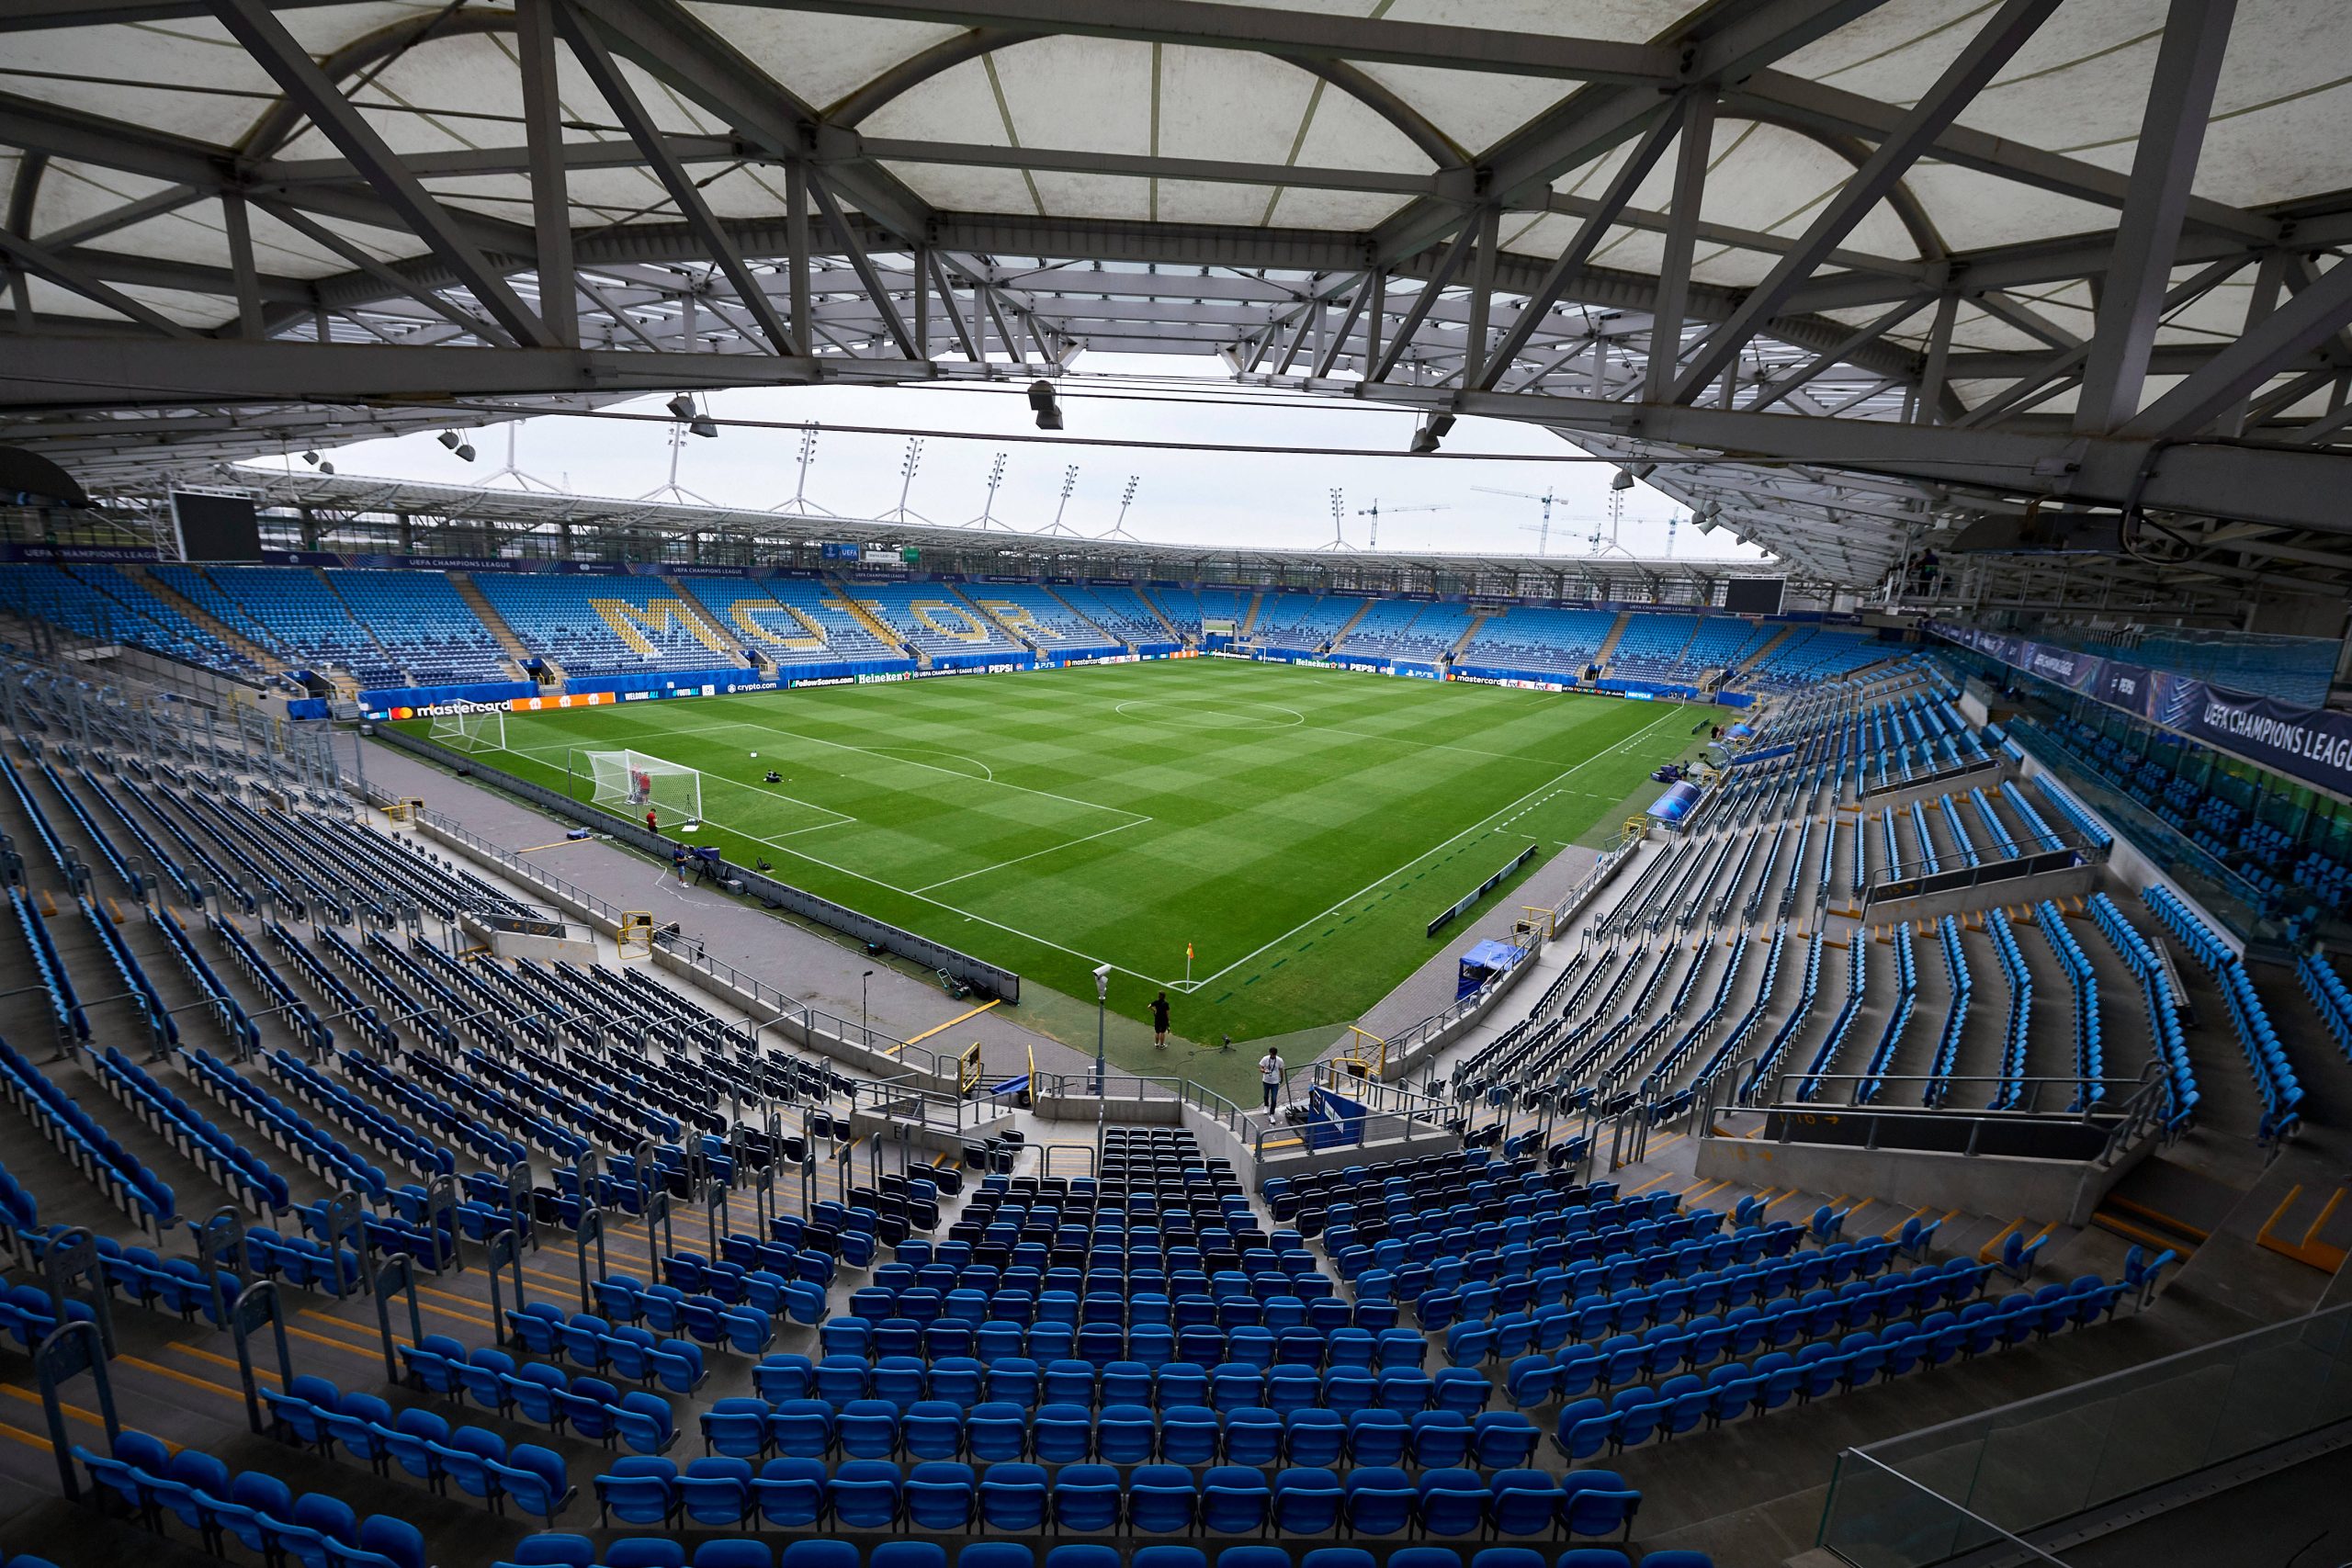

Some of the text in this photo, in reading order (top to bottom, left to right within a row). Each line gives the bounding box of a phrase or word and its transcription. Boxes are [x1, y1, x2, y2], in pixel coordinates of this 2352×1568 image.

[433, 559, 481, 568] CHAMPIONS
[989, 663, 1013, 673] PEPSI
[1295, 658, 1329, 669] Heineken
[1350, 662, 1376, 673] PEPSI
[858, 672, 902, 684] Heineken
[1415, 670, 1434, 679] PS5
[1457, 674, 1502, 686] mastercard
[737, 682, 777, 693] crypto.com
[795, 676, 854, 688] FollowScores.com
[625, 691, 659, 701] WELCOME ALL
[1574, 686, 1605, 695] FOUNDATION
[417, 700, 511, 717] mastercard
[2203, 703, 2352, 772] UEFA CHAMPIONS LEAG
